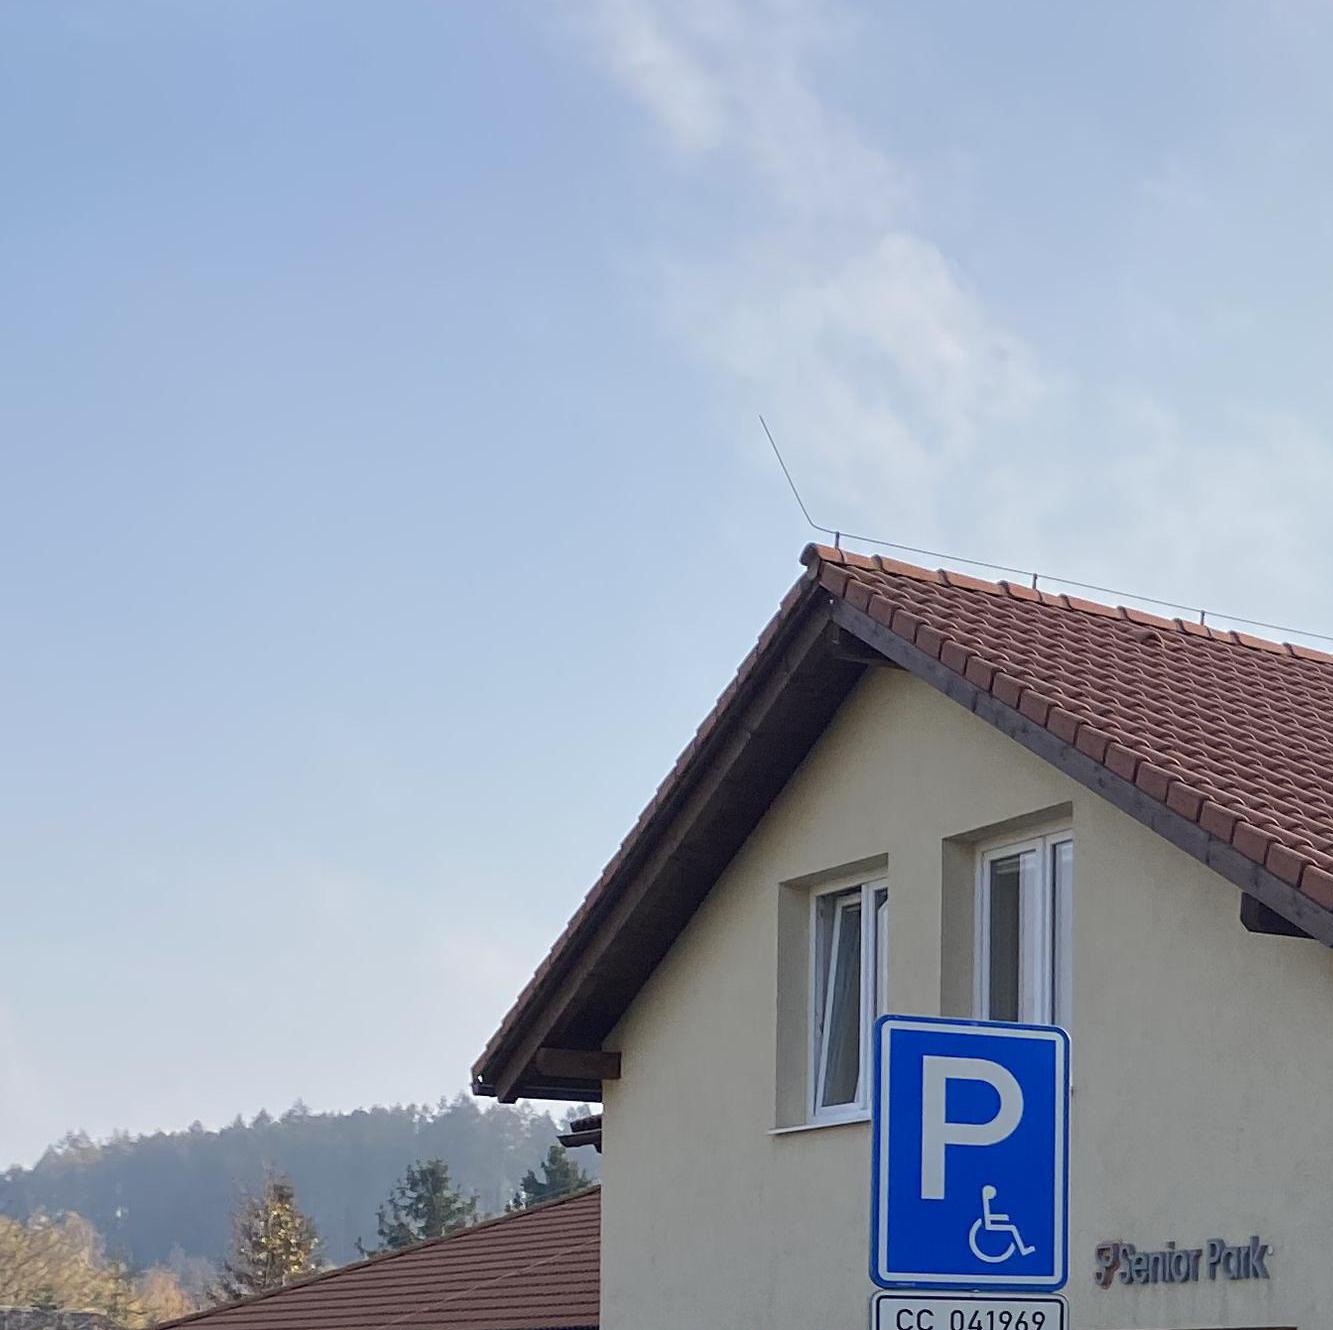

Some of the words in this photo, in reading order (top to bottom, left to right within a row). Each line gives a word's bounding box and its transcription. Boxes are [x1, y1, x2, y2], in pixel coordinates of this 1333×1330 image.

[920, 1054, 1024, 1200] P
[1119, 1241, 1203, 1285] Senior
[1207, 1235, 1271, 1281] Park
